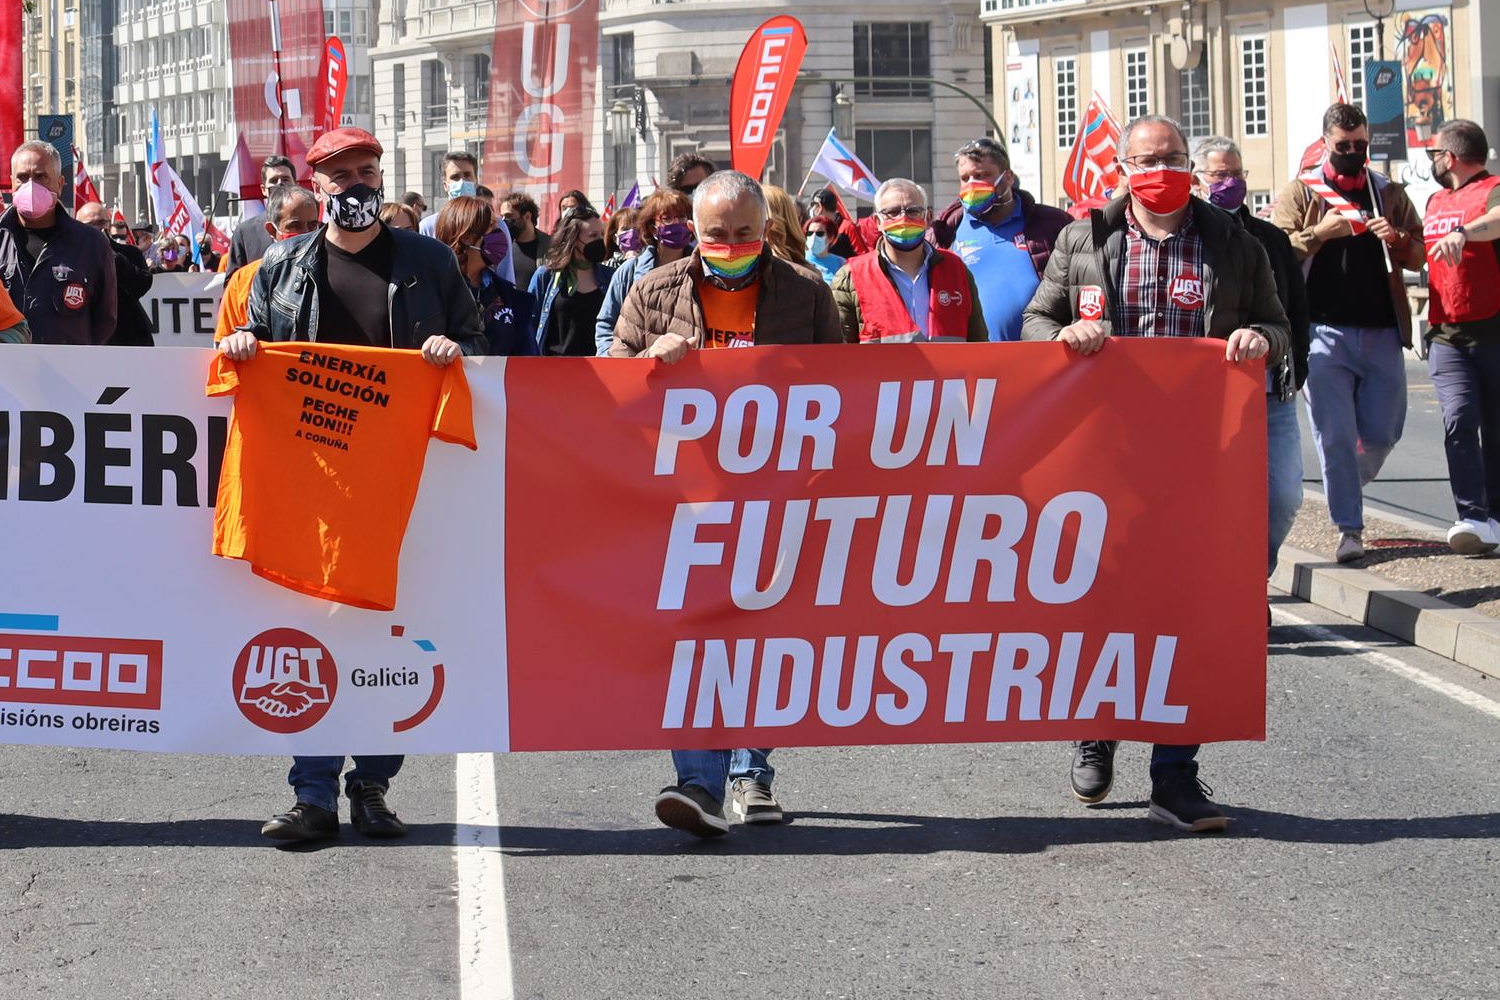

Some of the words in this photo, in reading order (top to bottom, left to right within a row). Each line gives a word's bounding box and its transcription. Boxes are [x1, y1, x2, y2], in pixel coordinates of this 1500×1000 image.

[742, 38, 786, 144] CCOO
[67, 286, 84, 297] UGT
[1080, 290, 1102, 306] UGT
[1174, 279, 1203, 295] UGT
[299, 350, 387, 385] ENERXÍA
[285, 367, 390, 408] SOLUCIÓN
[302, 396, 360, 422] PECHE
[299, 411, 354, 436] NON!!!
[654, 383, 842, 476] POR
[869, 377, 998, 470] UN
[295, 429, 303, 438] A
[305, 432, 349, 451] CORUÑA
[656, 490, 1109, 611] FUTURO
[245, 645, 324, 687] UGT
[351, 666, 419, 688] Galicia
[661, 631, 1190, 731] INDUSTRIAL
[72, 712, 160, 734] obreiras
